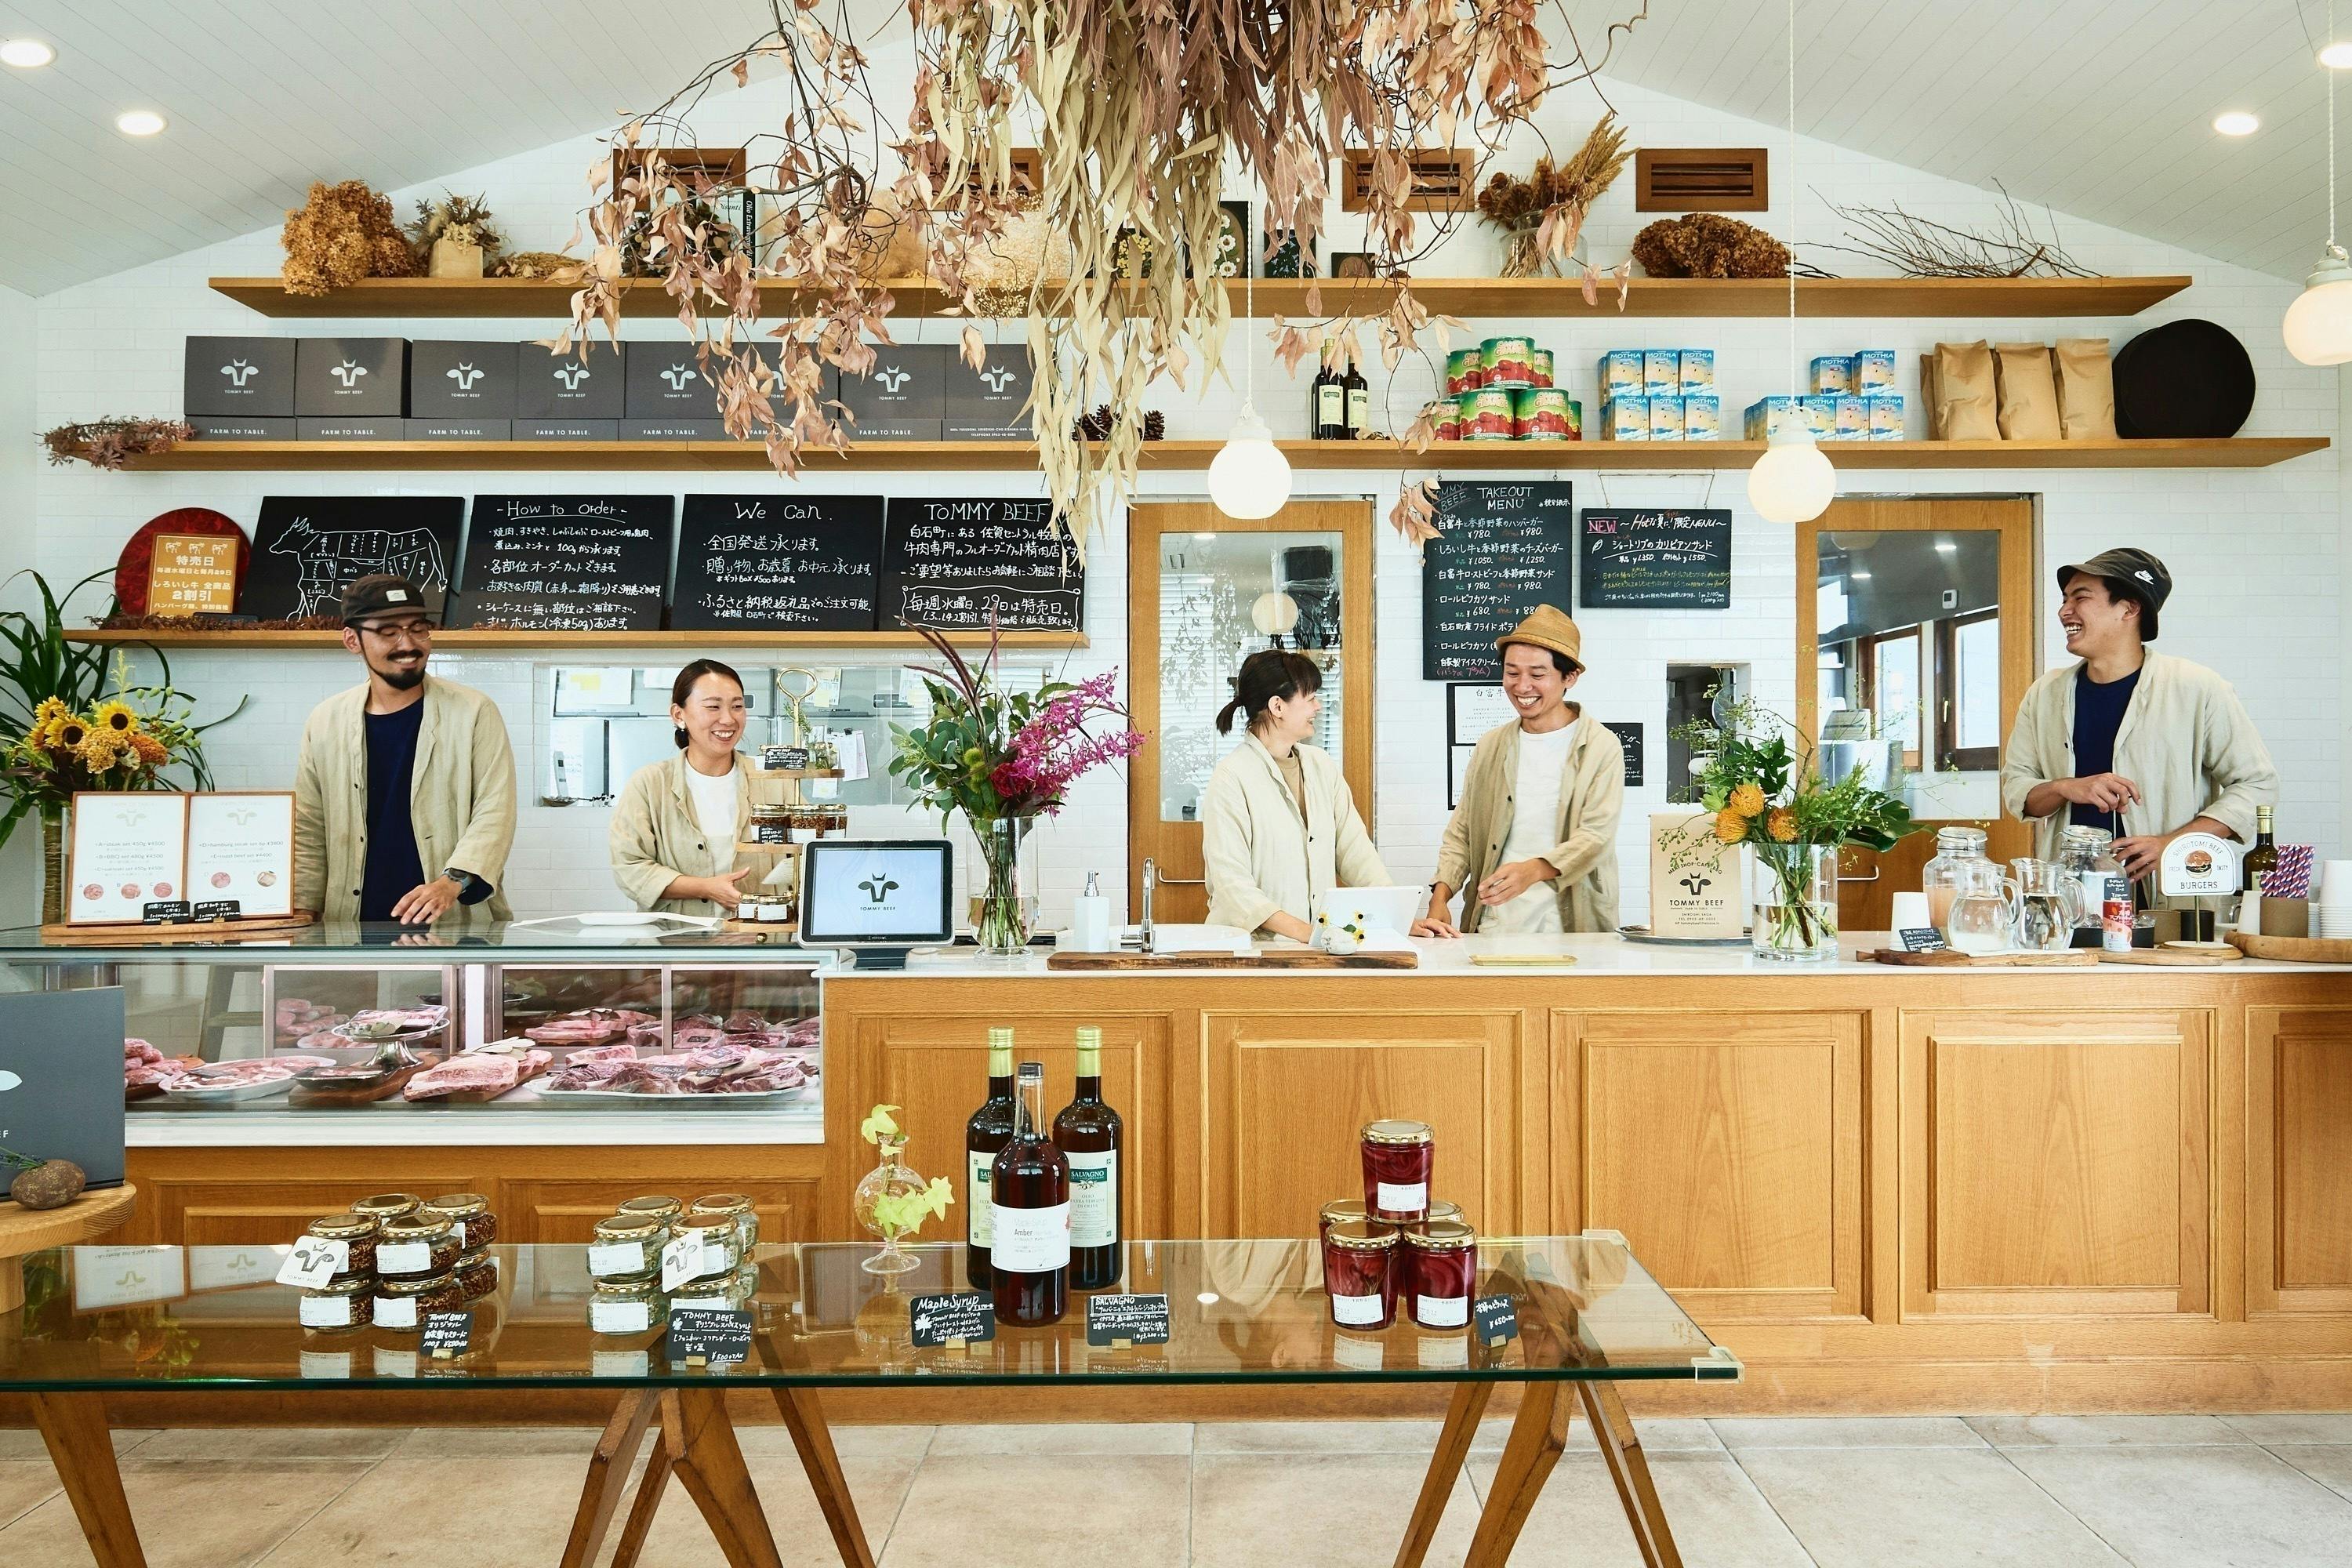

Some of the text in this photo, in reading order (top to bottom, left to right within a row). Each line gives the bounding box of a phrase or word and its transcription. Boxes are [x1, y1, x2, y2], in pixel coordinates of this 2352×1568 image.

[1436, 482, 1465, 499] OMMY
[1477, 486, 1534, 498] TAKEOUT
[1441, 492, 1466, 511] BEEF
[1487, 499, 1524, 510] MENU
[507, 500, 616, 517] How to Order
[735, 502, 766, 519] We
[1003, 503, 1051, 521] BEEF
[1588, 519, 1617, 532] NEW
[176, 555, 214, 566] 特売日
[154, 580, 199, 589] しろいし牛
[172, 590, 212, 601] 2割引
[2209, 843, 2224, 855] BEEF
[2180, 881, 2218, 890] BURGERS
[916, 1297, 949, 1312] Maple
[949, 1294, 979, 1312] Syrup
[1095, 1297, 1135, 1305] SALVAGNO
[716, 1314, 735, 1323] BEEF
